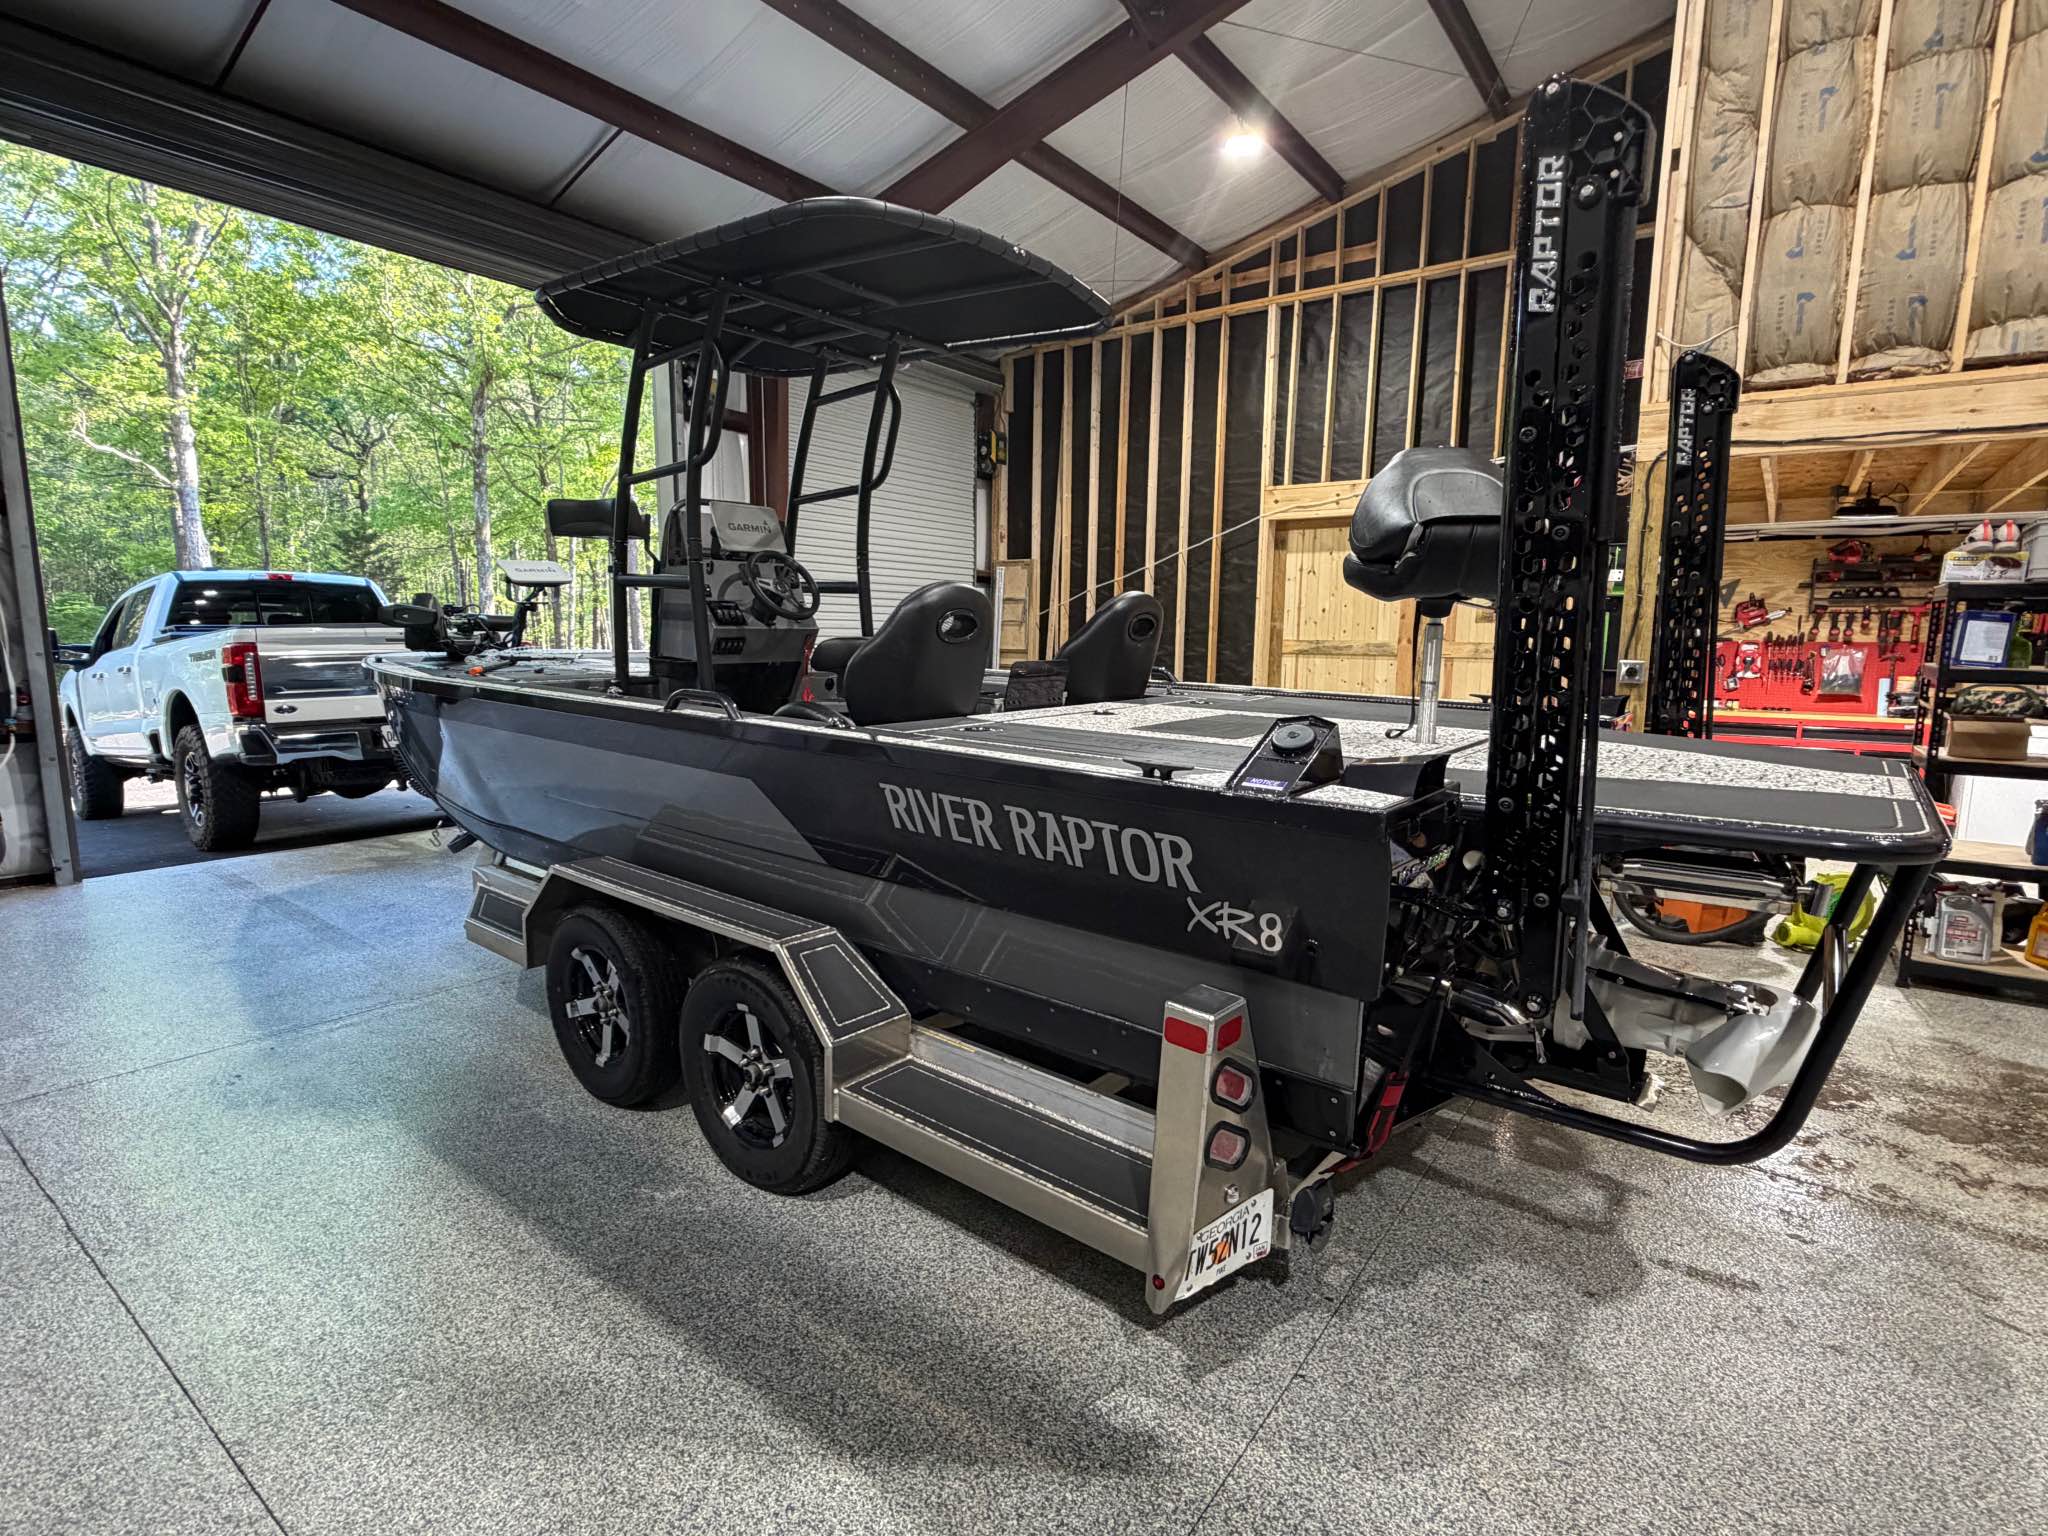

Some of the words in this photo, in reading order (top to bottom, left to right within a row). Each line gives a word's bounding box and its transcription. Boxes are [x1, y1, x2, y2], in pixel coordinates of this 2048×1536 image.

[1528, 155, 1565, 313] RAPTOR
[1677, 389, 1696, 465] RAPTOR
[728, 521, 772, 534] GARMIN
[1250, 778, 1281, 786] NOTICE
[879, 782, 1002, 851] RIVER
[1003, 804, 1201, 892] RAPTOR
[1186, 896, 1283, 952] XR8
[1200, 1206, 1250, 1242] GEORGIA
